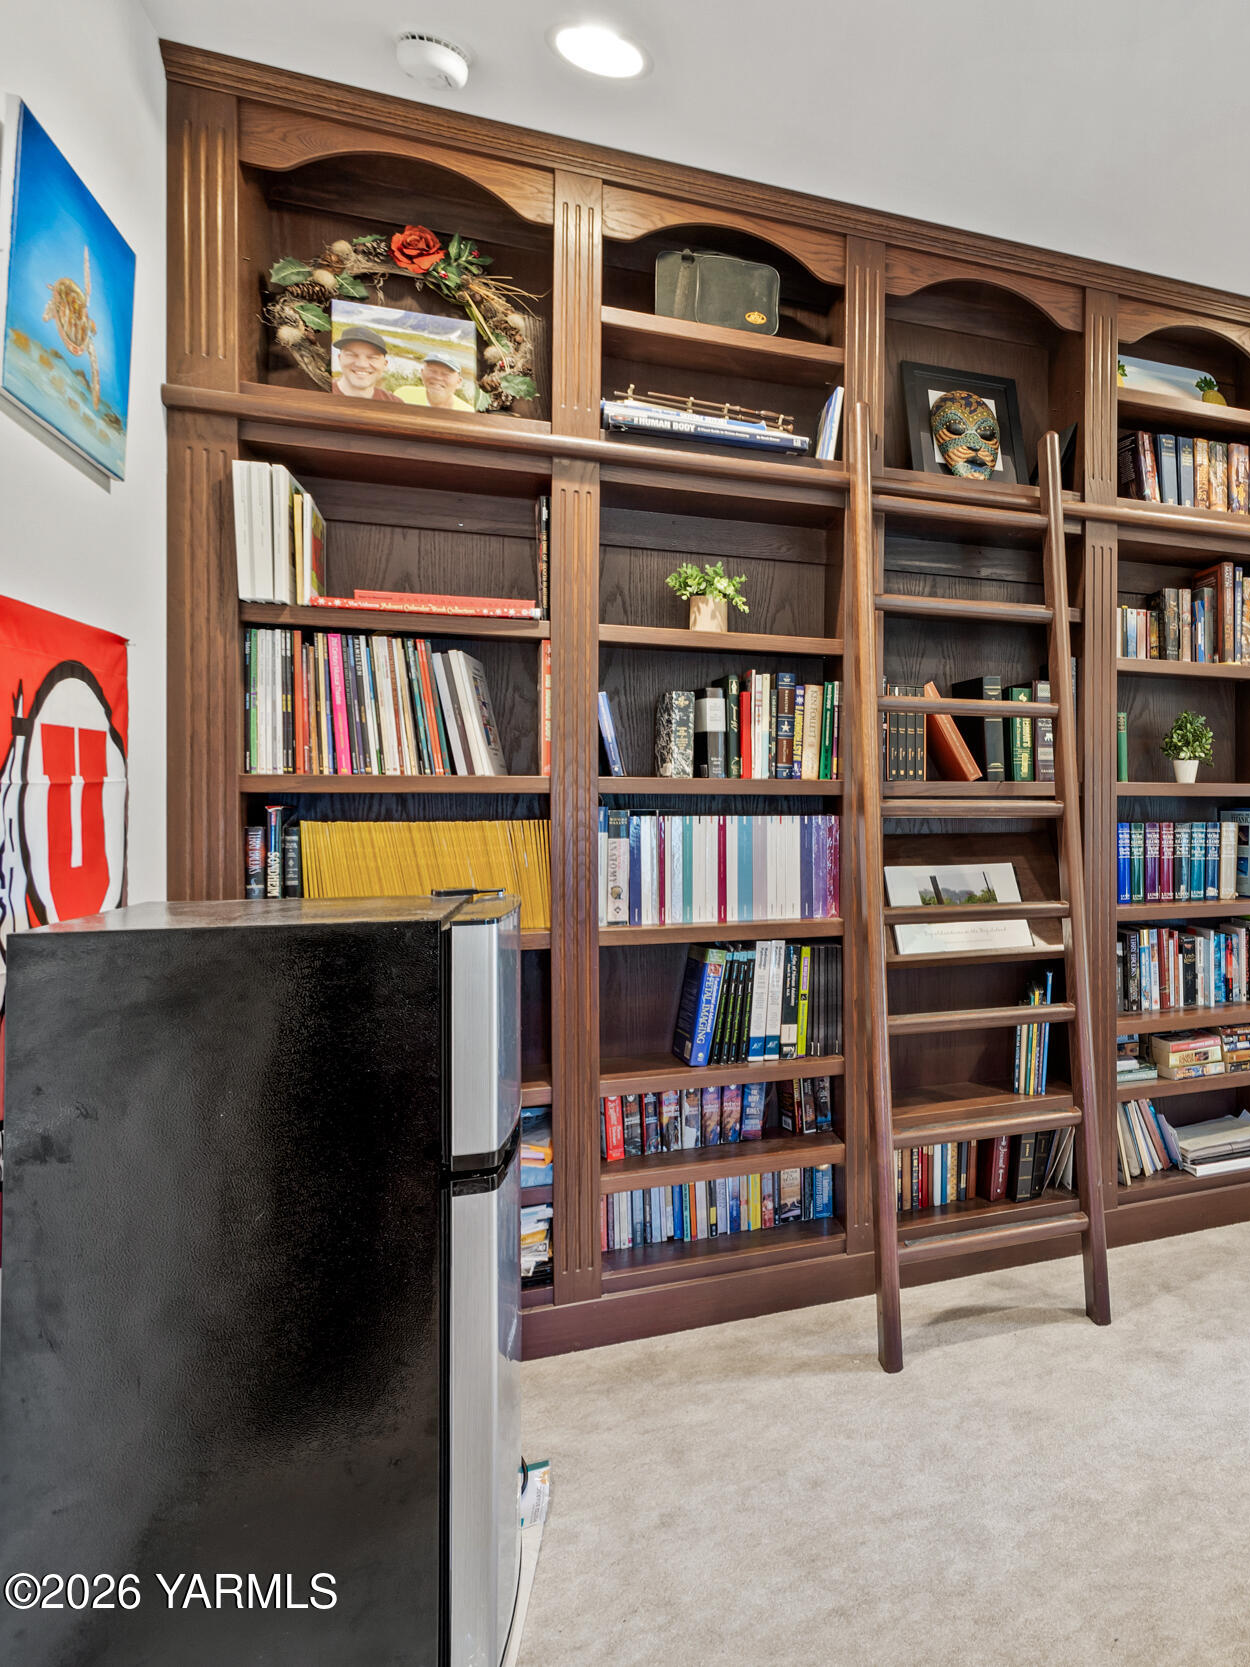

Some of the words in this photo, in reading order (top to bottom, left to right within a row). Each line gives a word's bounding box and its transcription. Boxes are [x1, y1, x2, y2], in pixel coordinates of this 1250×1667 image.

[639, 418, 671, 430] HUMAN
[673, 422, 696, 433] BODY
[810, 690, 818, 705] KEN
[808, 707, 818, 739] FOLLETT
[267, 852, 279, 896] SONDHEIM
[609, 840, 617, 883] ANATOMY
[702, 977, 714, 1002] FETAL
[697, 1004, 710, 1044] IMAGING
[746, 1106, 761, 1115] KINGS
